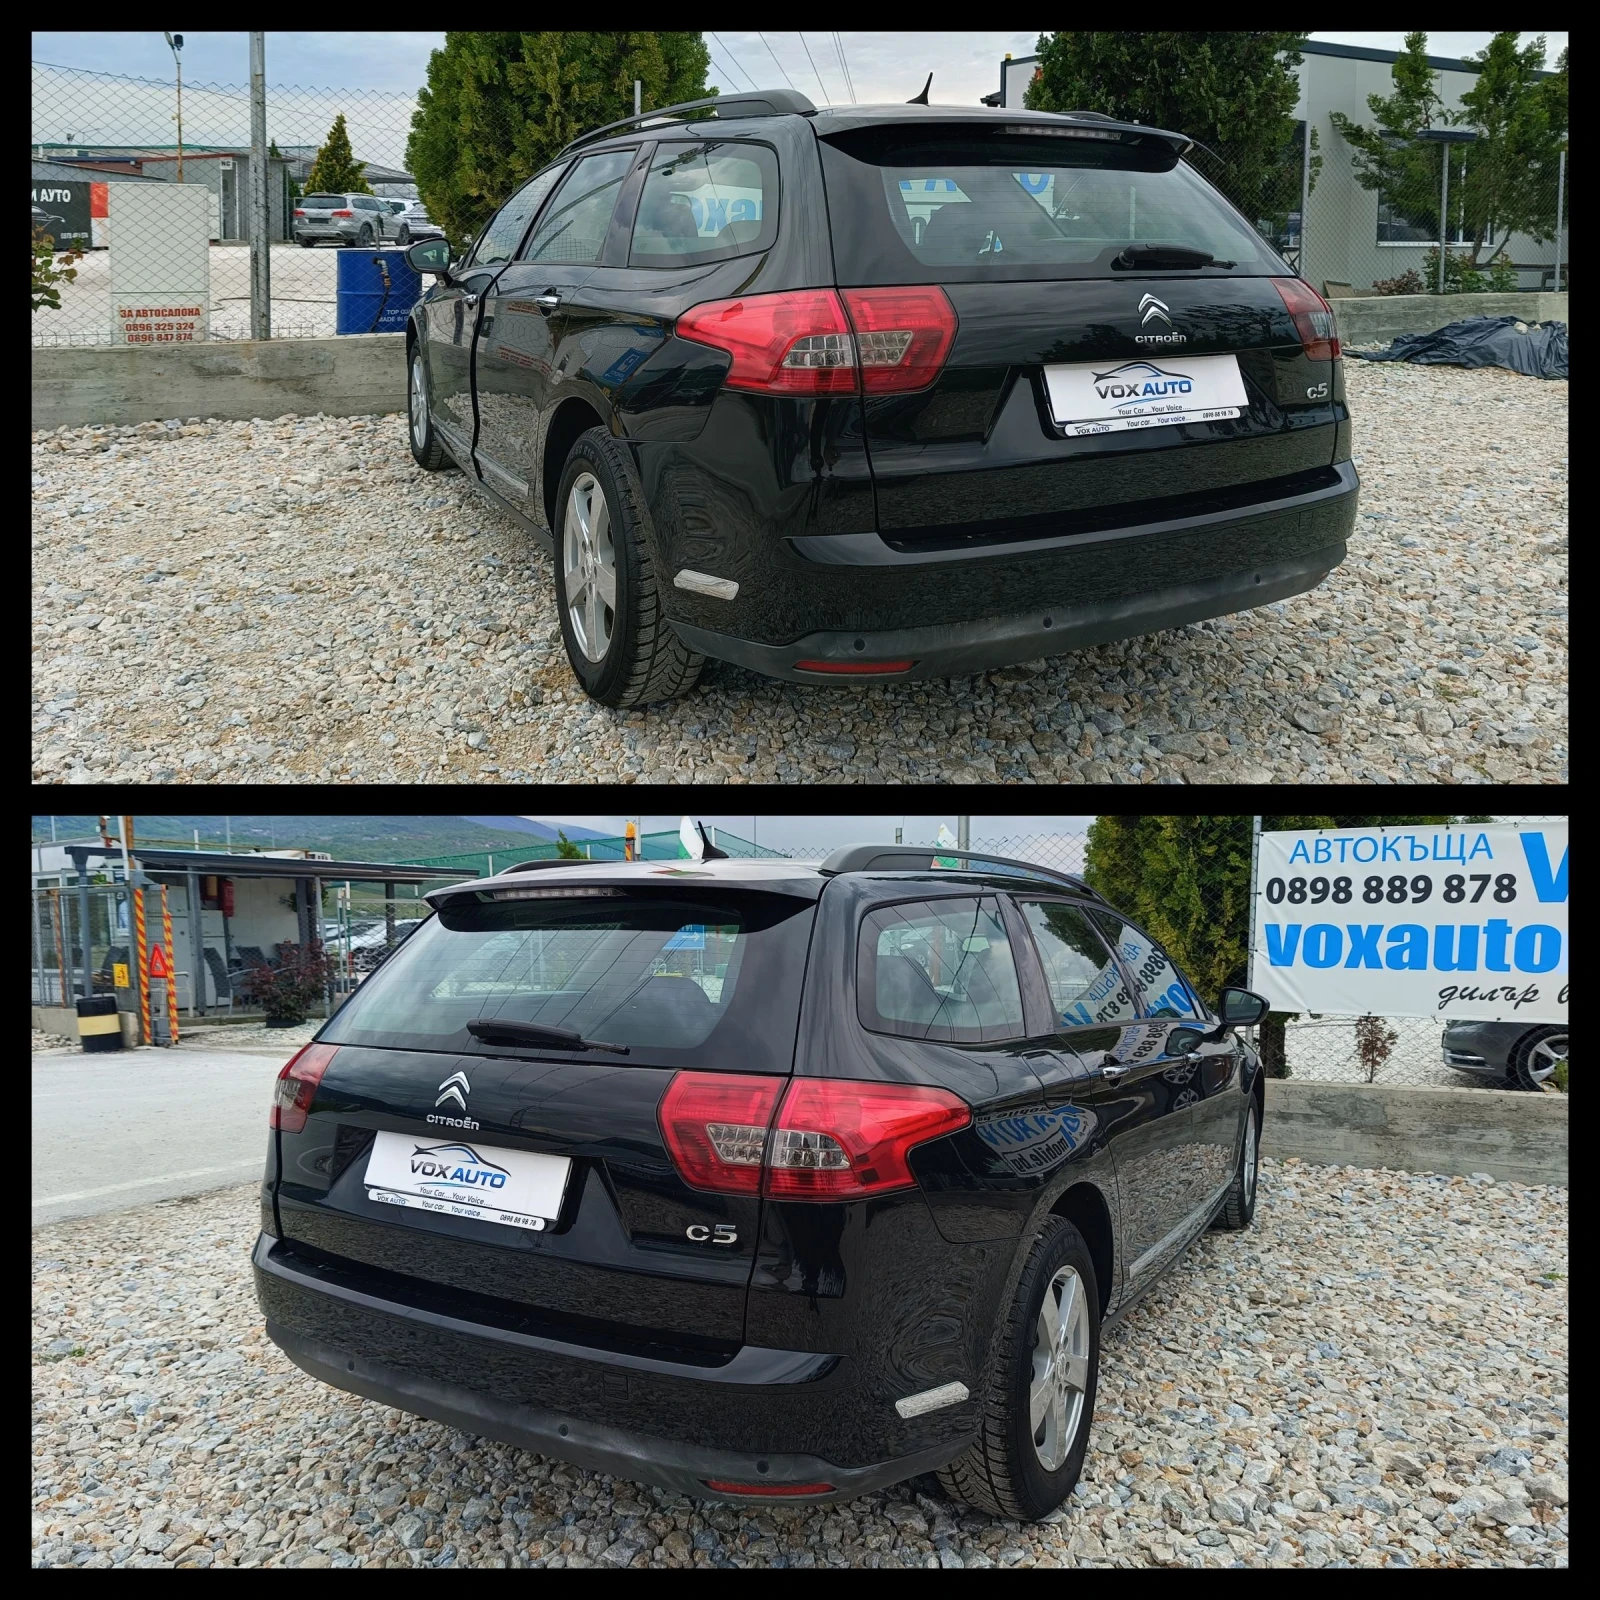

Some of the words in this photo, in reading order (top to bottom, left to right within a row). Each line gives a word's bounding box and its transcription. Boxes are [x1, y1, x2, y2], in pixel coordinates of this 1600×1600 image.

[120, 310, 134, 318] ЗА
[136, 308, 201, 318] АВТОСАЛОНА
[126, 324, 152, 332] 0896
[154, 322, 174, 331] 325
[176, 322, 194, 330] 324
[128, 334, 154, 342] 0896
[1306, 382, 1328, 399] C5
[1288, 833, 1494, 866] АВТОКЪЩА
[1266, 876, 1353, 904] 0898
[1362, 874, 1433, 904] 889
[1442, 874, 1517, 904] 878
[1264, 919, 1562, 974] voxauto
[420, 1186, 433, 1194] Your
[451, 1205, 465, 1214] Your
[686, 1224, 738, 1244] C5
